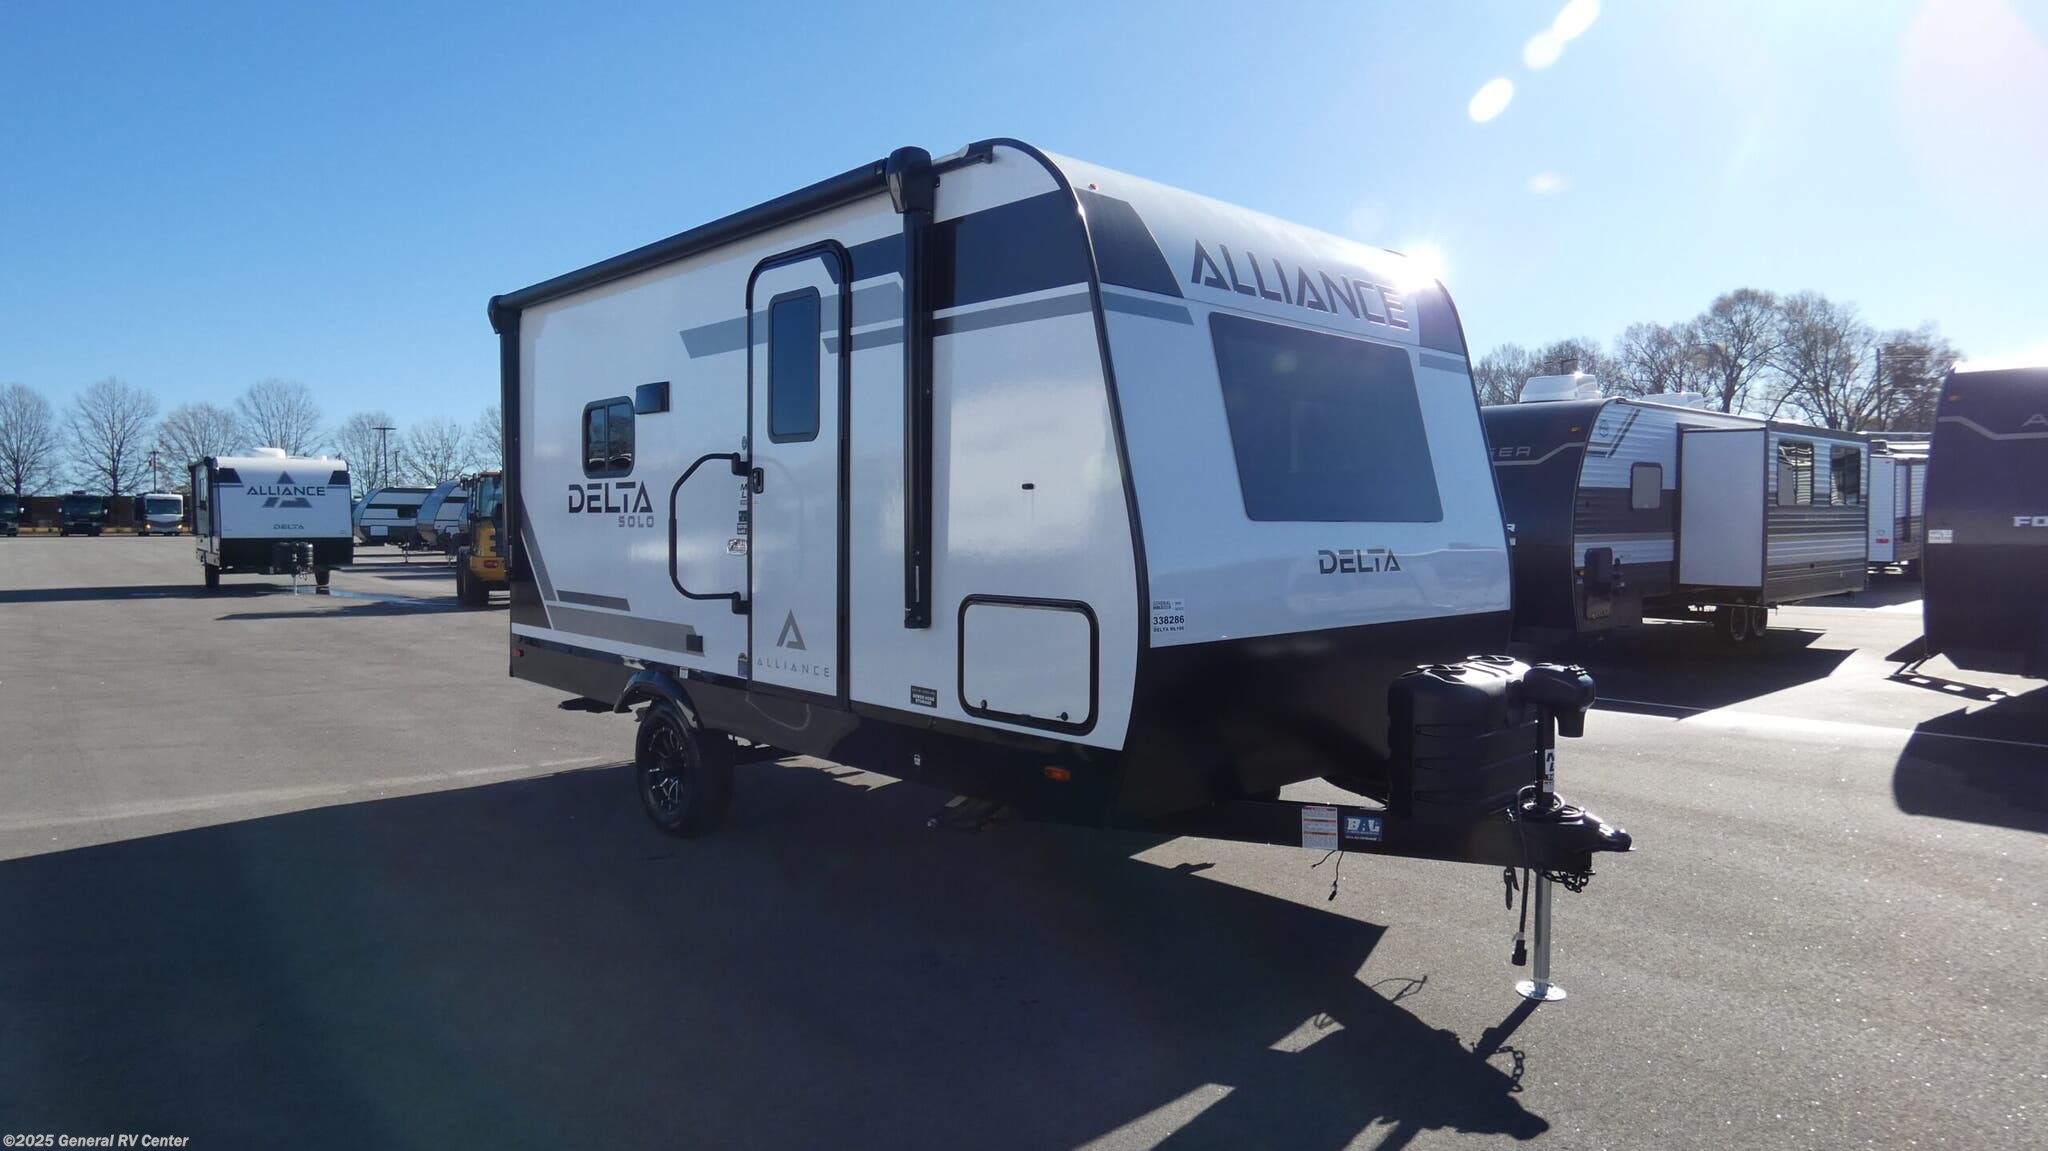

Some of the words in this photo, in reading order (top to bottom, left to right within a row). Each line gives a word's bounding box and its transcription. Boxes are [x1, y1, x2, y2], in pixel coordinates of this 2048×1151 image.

[1191, 238, 1410, 331] ALLIANCE
[246, 485, 326, 496] ALLIANCE
[568, 480, 653, 513] DELTA
[618, 515, 654, 528] SOLO
[1318, 548, 1401, 574] DELTA
[1153, 615, 1185, 625] 338286
[757, 657, 830, 678] ALLIANCE
